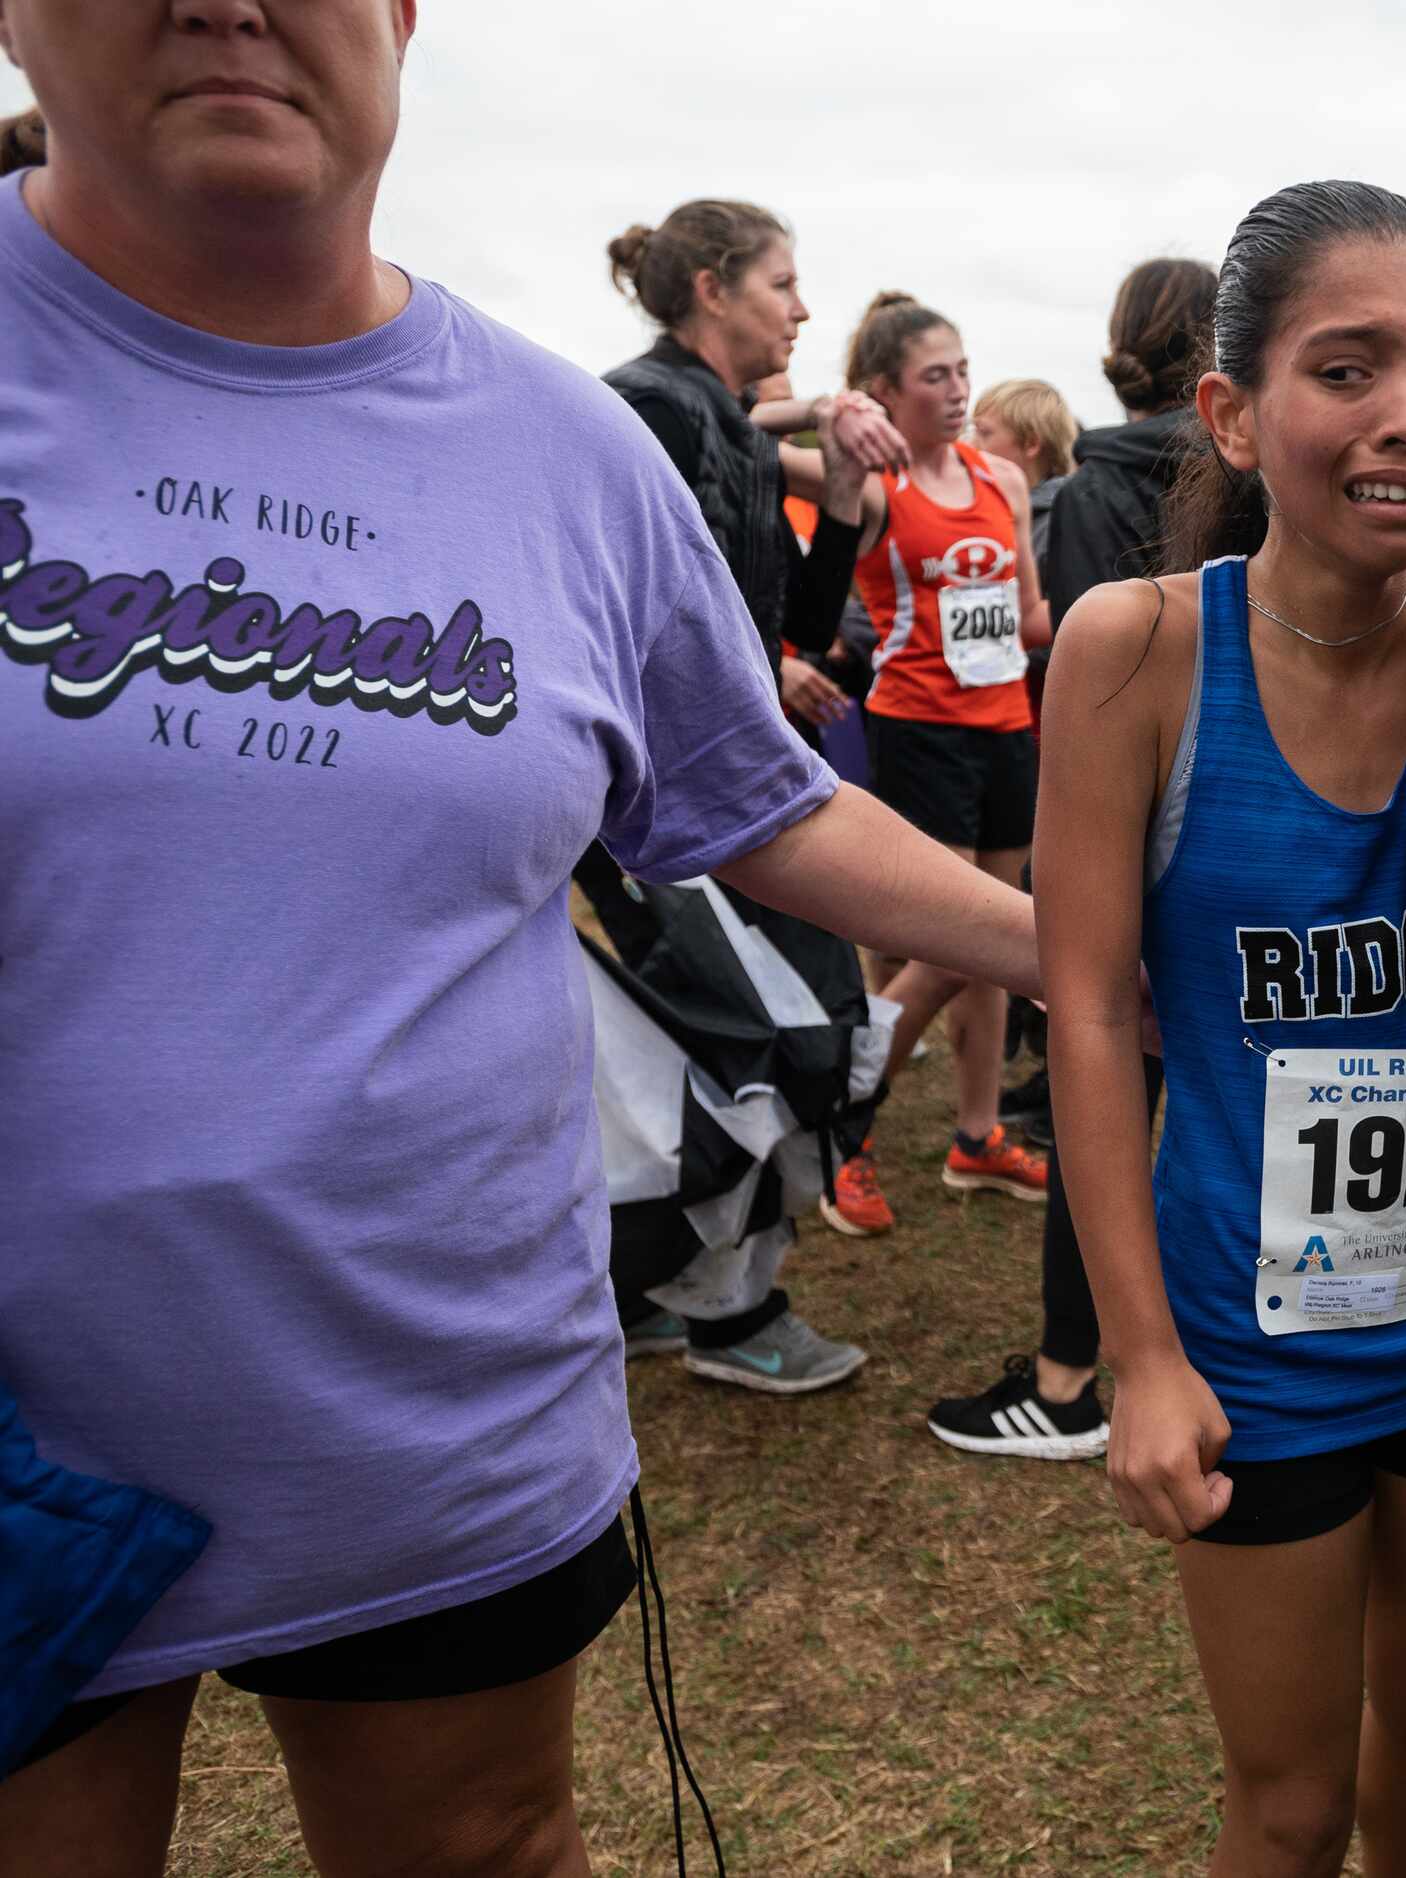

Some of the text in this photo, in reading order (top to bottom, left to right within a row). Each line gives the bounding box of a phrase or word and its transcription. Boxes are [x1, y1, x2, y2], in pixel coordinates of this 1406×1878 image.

[156, 477, 361, 552] OAK RIDGE
[0, 498, 518, 737] egionals
[150, 703, 341, 769] XC 2022
[1339, 1057, 1380, 1076] UIL
[1307, 1085, 1343, 1103] XC
[1343, 1234, 1361, 1246] The
